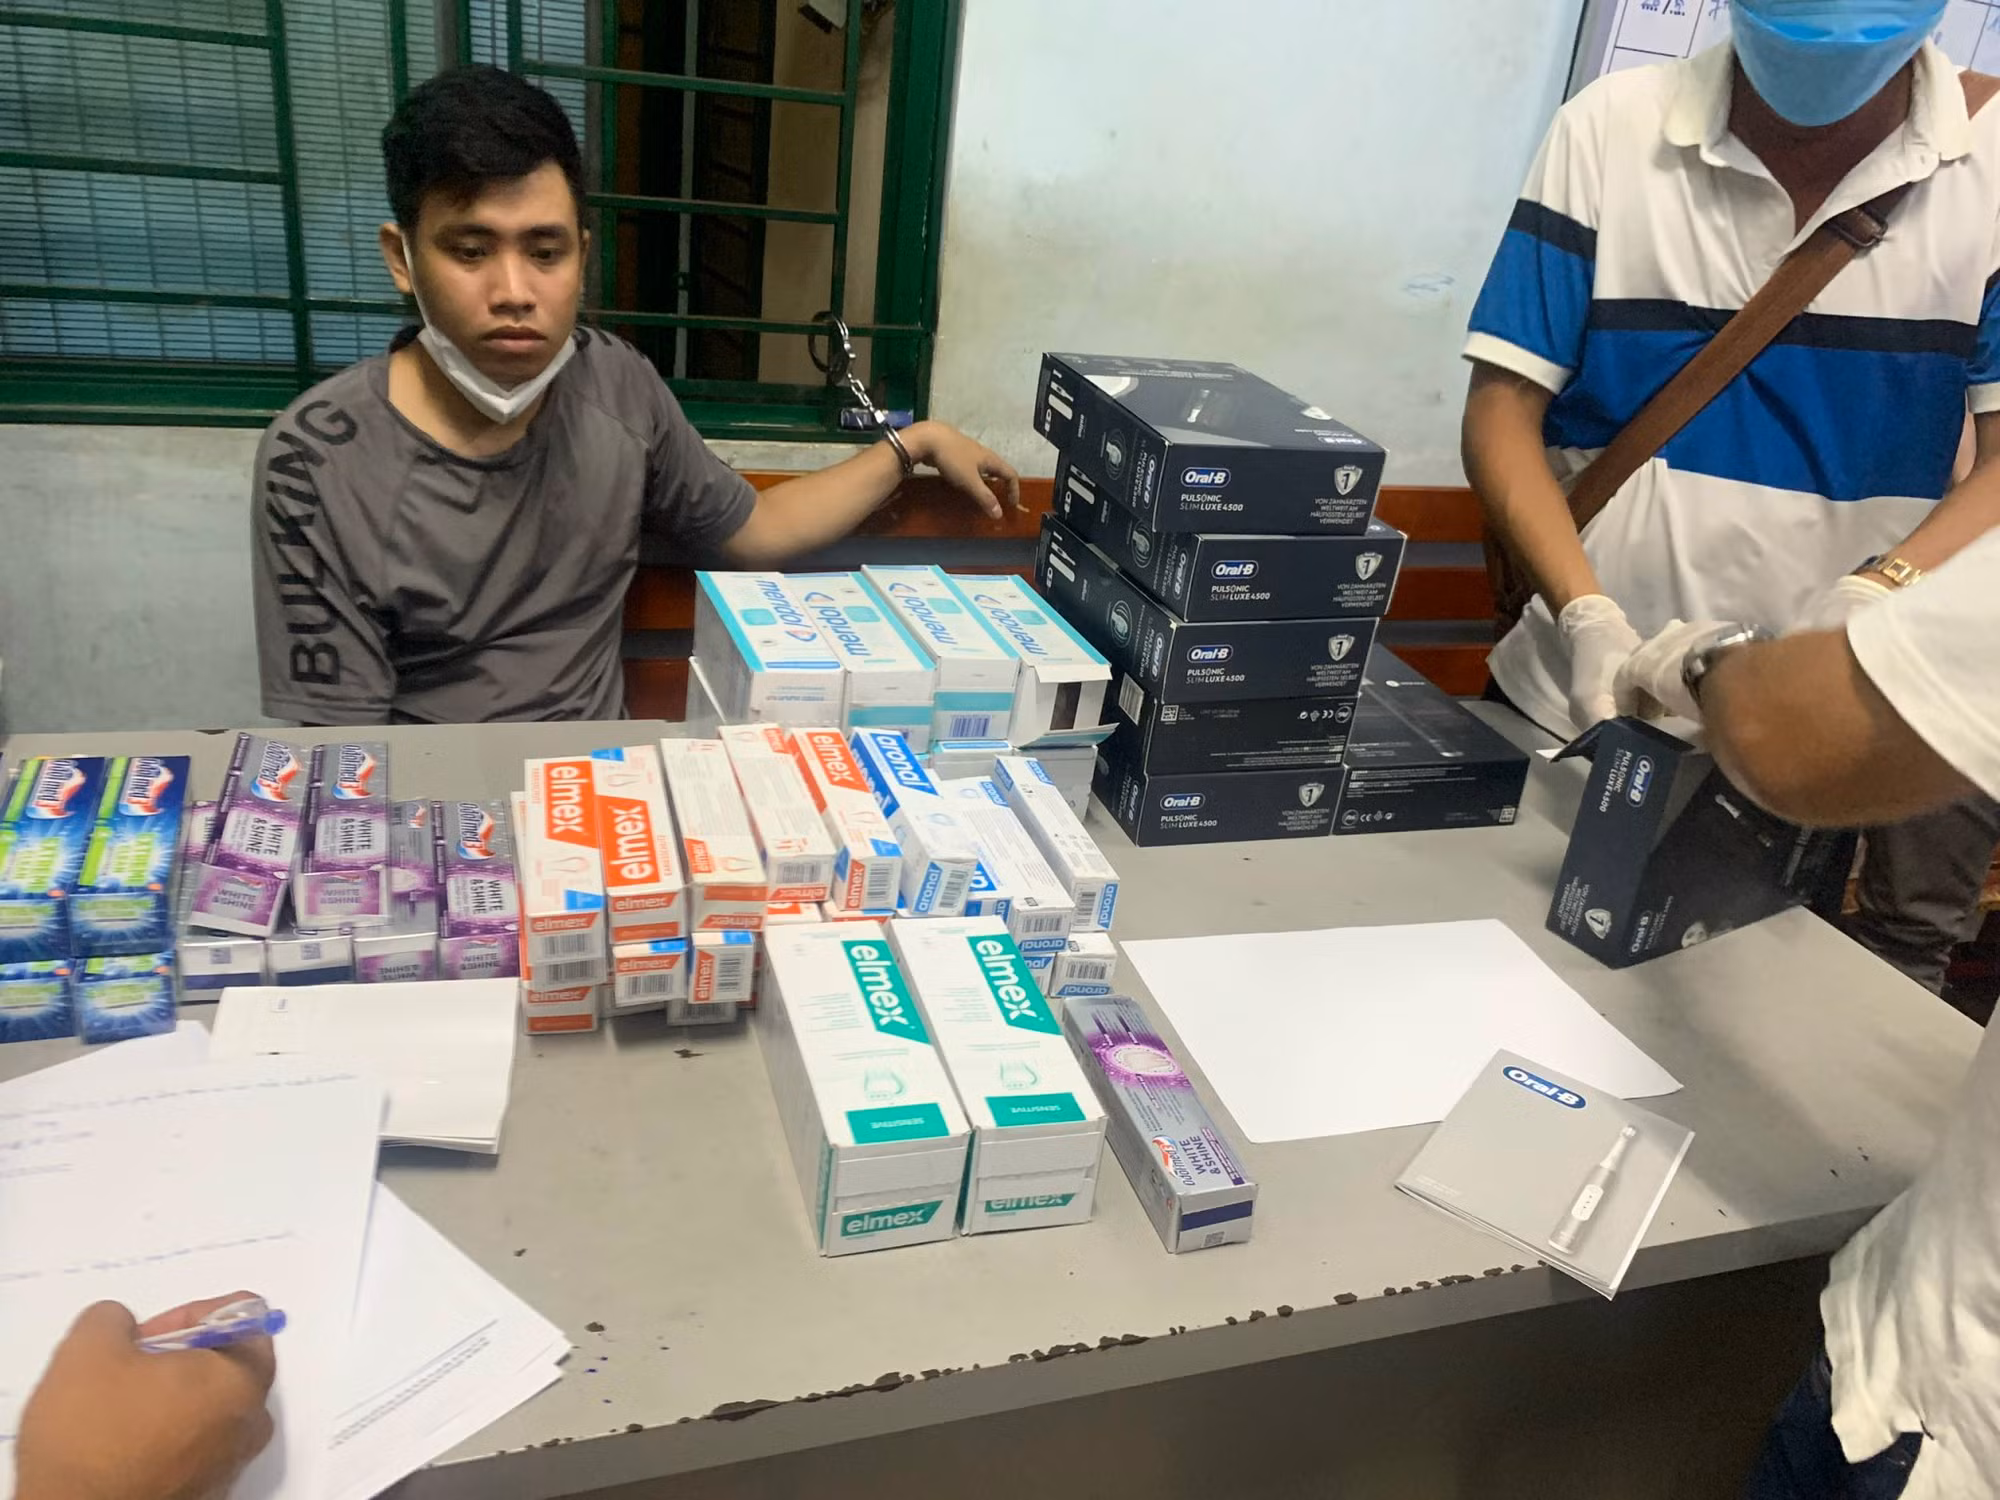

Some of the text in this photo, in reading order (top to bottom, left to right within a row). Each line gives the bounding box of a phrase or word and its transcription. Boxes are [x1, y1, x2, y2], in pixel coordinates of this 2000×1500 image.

[1185, 471, 1226, 484] Oral-B
[1181, 493, 1222, 502] PULSONIC
[265, 399, 358, 685] BULKING
[1215, 564, 1254, 576] Oral-B
[755, 580, 812, 628] meridol
[1211, 585, 1251, 594] PULSONIC
[809, 606, 872, 656] meridol
[894, 595, 958, 645] meridol
[980, 605, 1048, 655] meridol
[1187, 668, 1225, 676] PULSONIC
[1191, 648, 1229, 660] Oral-B
[813, 735, 854, 782] elmex
[876, 735, 929, 786] aronal
[1613, 751, 1633, 794] PULSONIC
[1630, 759, 1650, 803] Oral-B
[550, 766, 590, 834] elmex
[1160, 814, 1198, 823] PULSONIC
[1164, 796, 1201, 808] Oral-B
[263, 824, 284, 856] WHITE
[356, 819, 373, 851] WHITE
[610, 806, 654, 880] elmex
[487, 879, 504, 911] WHITE
[616, 896, 668, 910] elmex
[850, 868, 865, 908] elmex
[918, 869, 943, 913] aronal
[1100, 885, 1115, 925] aronal
[534, 917, 589, 931] elmex
[1022, 939, 1065, 950] aronal
[697, 959, 712, 1000] elmex
[850, 945, 910, 1027] elmex
[976, 940, 1038, 1021] elmex
[1065, 985, 1109, 994] aronal
[1508, 1069, 1580, 1105] Oral-B
[1178, 1138, 1207, 1175] WHITE
[846, 1208, 927, 1234] elmex
